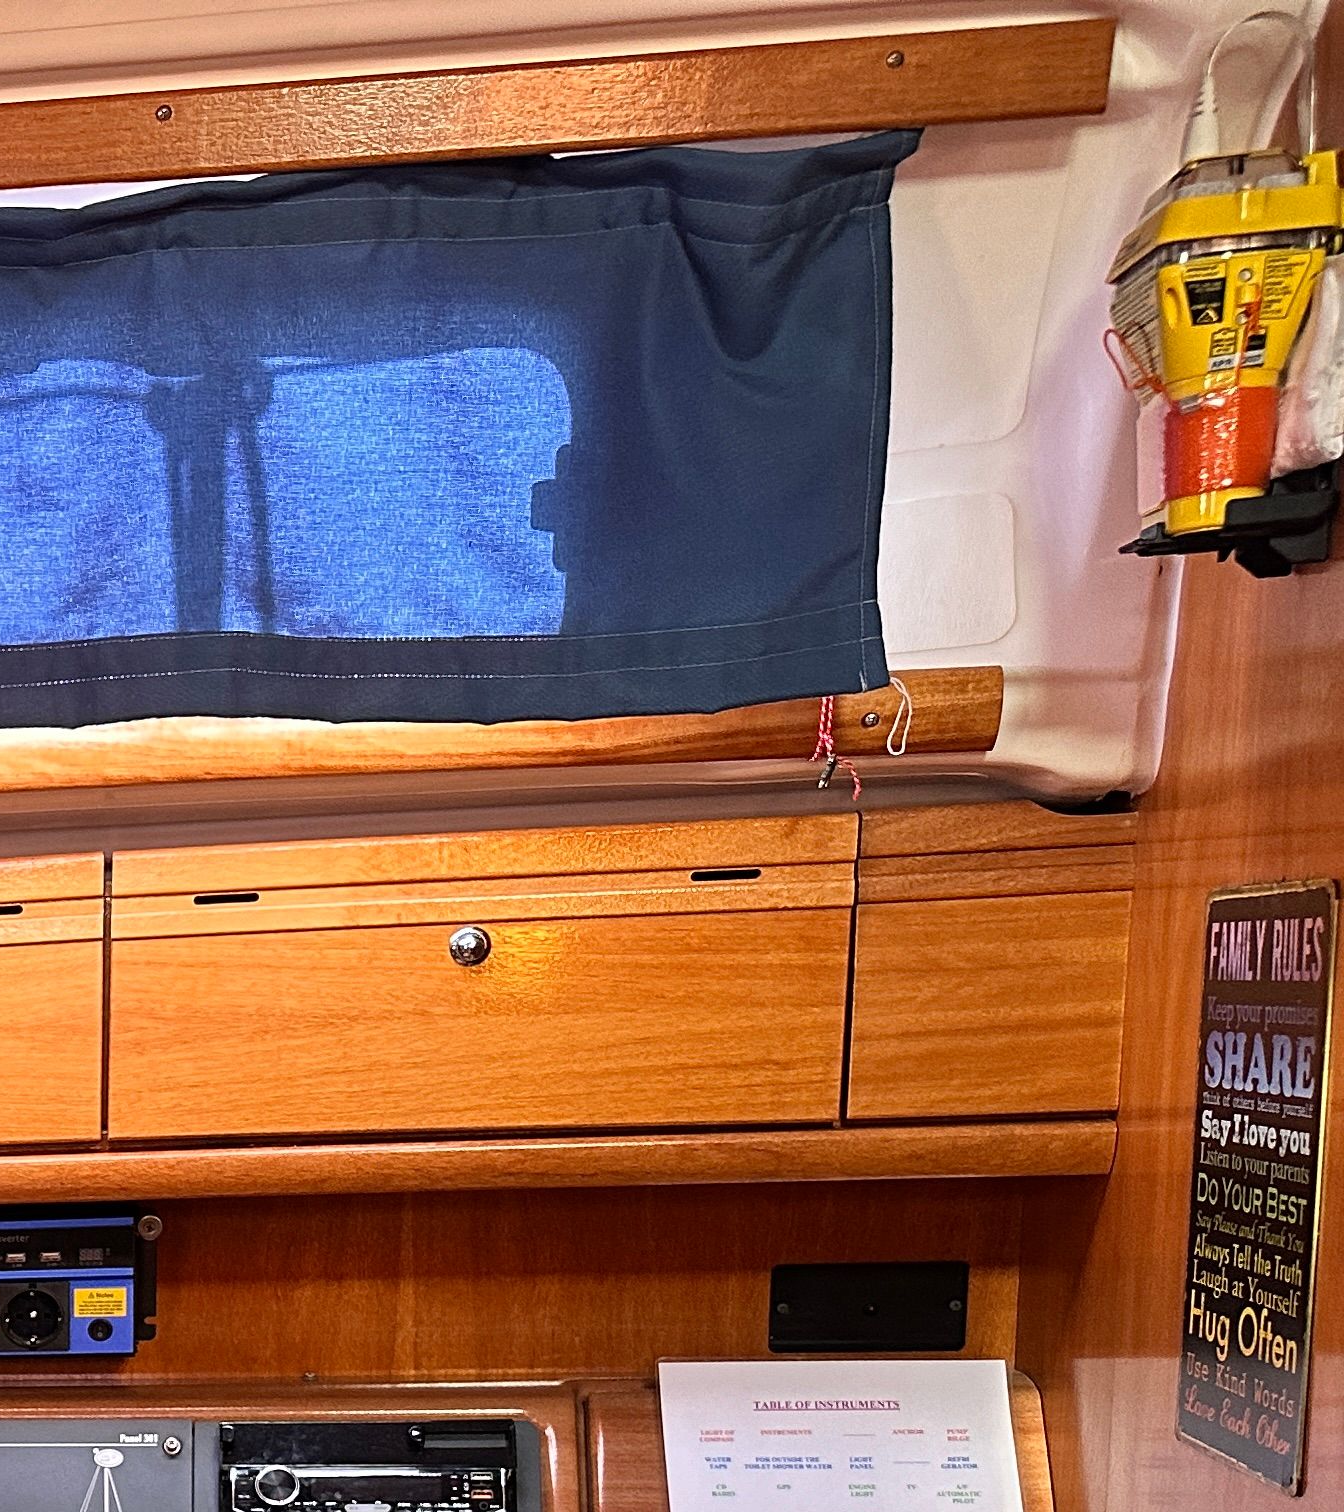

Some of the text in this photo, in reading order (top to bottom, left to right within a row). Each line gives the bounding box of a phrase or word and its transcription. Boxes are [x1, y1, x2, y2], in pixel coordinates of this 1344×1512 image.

[1209, 917, 1324, 981] FAMILY RULES
[1207, 996, 1318, 1031] Keep your promises
[1204, 1030, 1316, 1099] SHARE
[1201, 1110, 1311, 1157] Say I love you
[1200, 1142, 1310, 1184] Listen to your parents
[1194, 1233, 1302, 1287] Always Tell the Truth
[1239, 1219, 1258, 1239] and
[1257, 1222, 1287, 1248] Thank
[1193, 1259, 1301, 1318] Laugh at Yourself
[1189, 1289, 1298, 1374] Hug Often
[753, 1400, 900, 1410] TABLE OF INSTRUMENTS
[1186, 1352, 1295, 1418] Use Kind Words
[1184, 1384, 1290, 1455] Love Each Other
